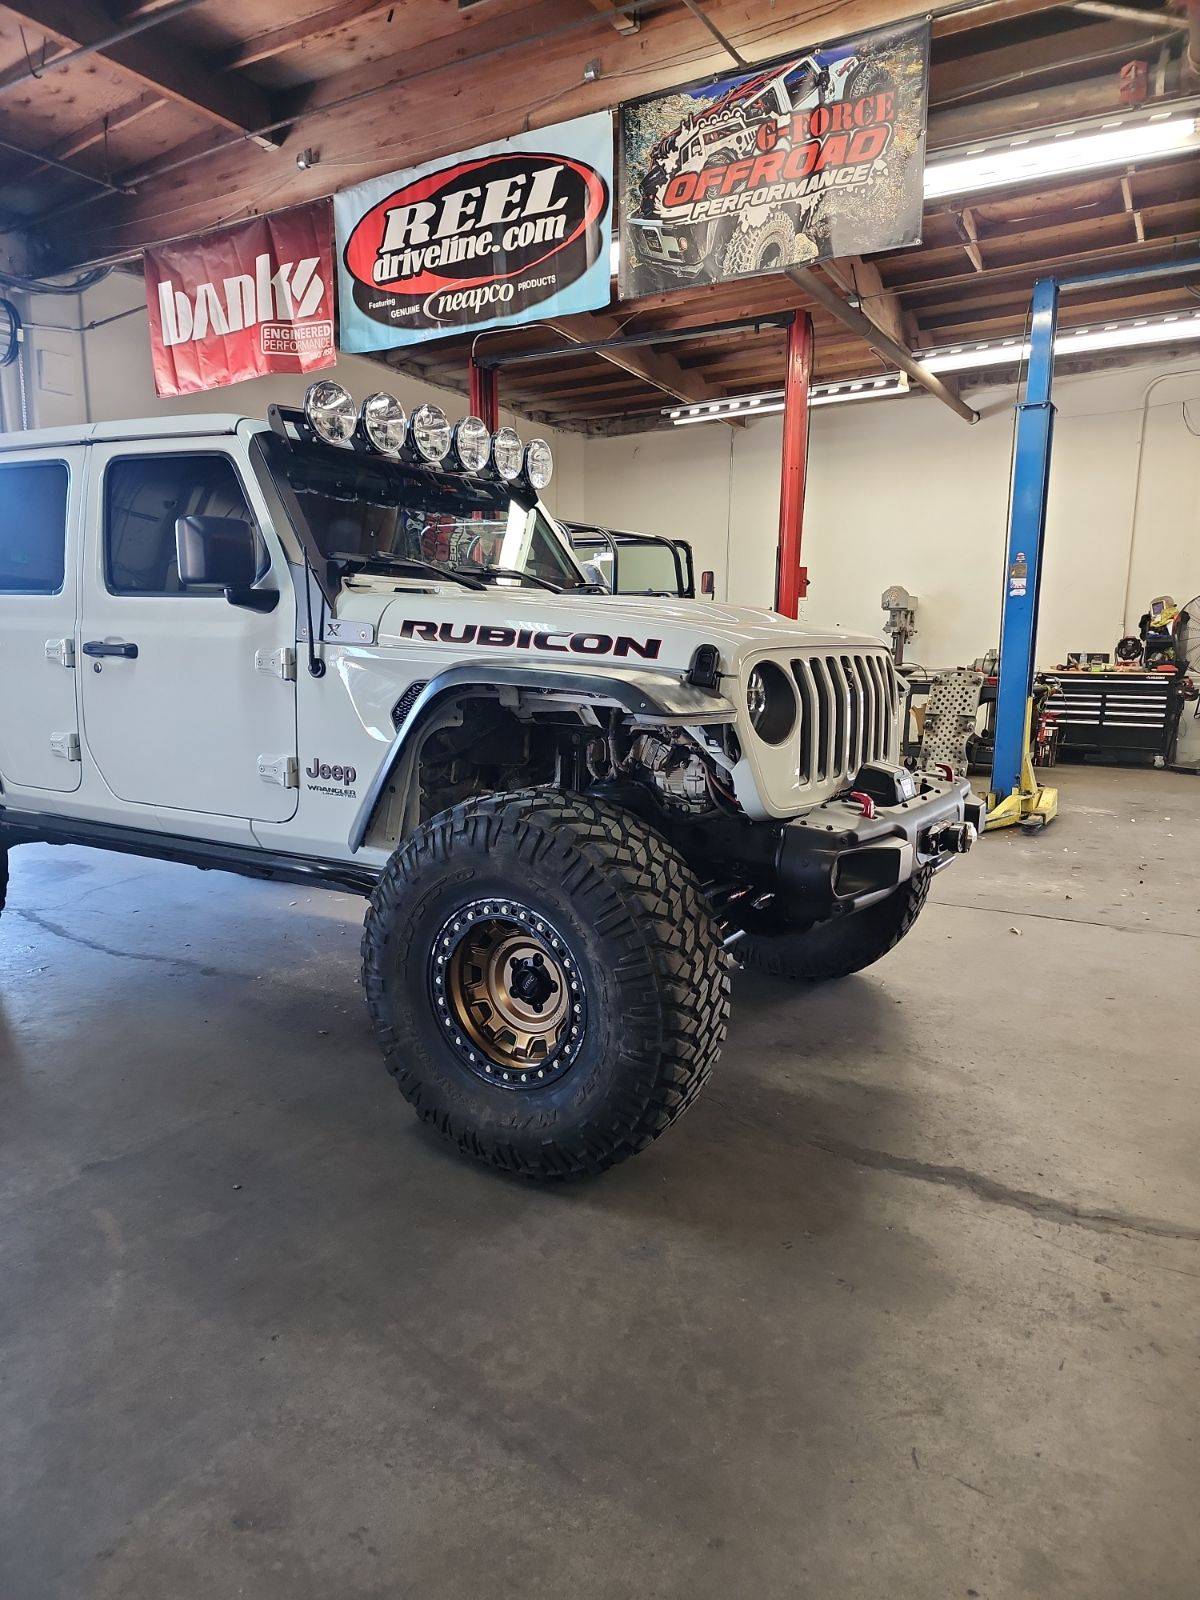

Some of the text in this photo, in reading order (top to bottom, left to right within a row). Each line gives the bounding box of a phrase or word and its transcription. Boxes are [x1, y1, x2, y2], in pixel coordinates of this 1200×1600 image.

[756, 92, 896, 150] G-FORCE
[663, 127, 888, 206] OFFROAD
[379, 165, 569, 253] REEL
[692, 165, 871, 219] PERFORMANCE
[371, 215, 567, 284] driveline.com
[368, 298, 396, 310] Featuring
[390, 274, 557, 319] GENUINE neapco PRODUCTS
[263, 325, 331, 340] ENGINEERED
[263, 337, 331, 352] PERFORMANCE
[399, 620, 663, 660] RUBICON
[305, 757, 357, 786] Jeep
[306, 784, 356, 796] WRANGLER
